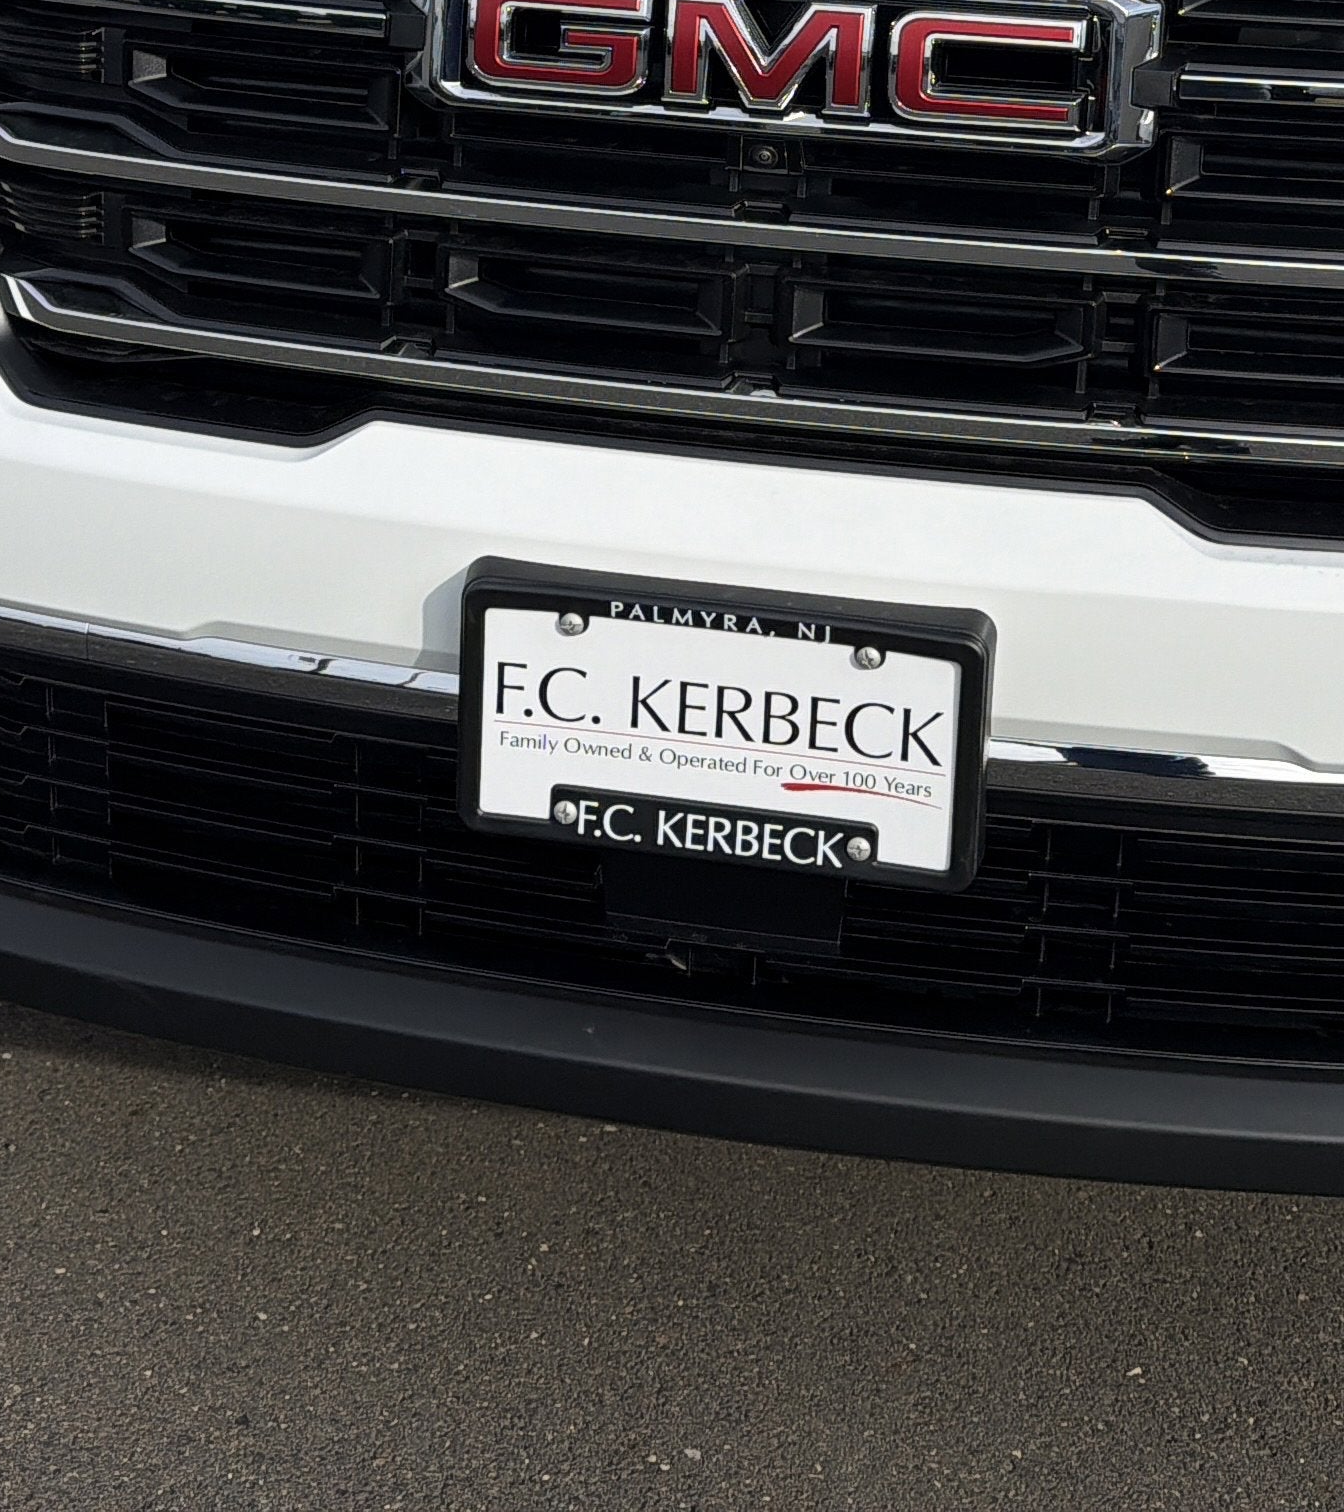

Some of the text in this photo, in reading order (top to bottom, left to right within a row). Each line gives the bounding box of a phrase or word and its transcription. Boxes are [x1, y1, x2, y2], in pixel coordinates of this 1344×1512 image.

[798, 622, 833, 644] NJ
[495, 660, 945, 768] F.C. KERBECK
[499, 730, 933, 799] Family Owned & Operated For Over 100 Years
[576, 800, 844, 869] F.C. KERBECK
